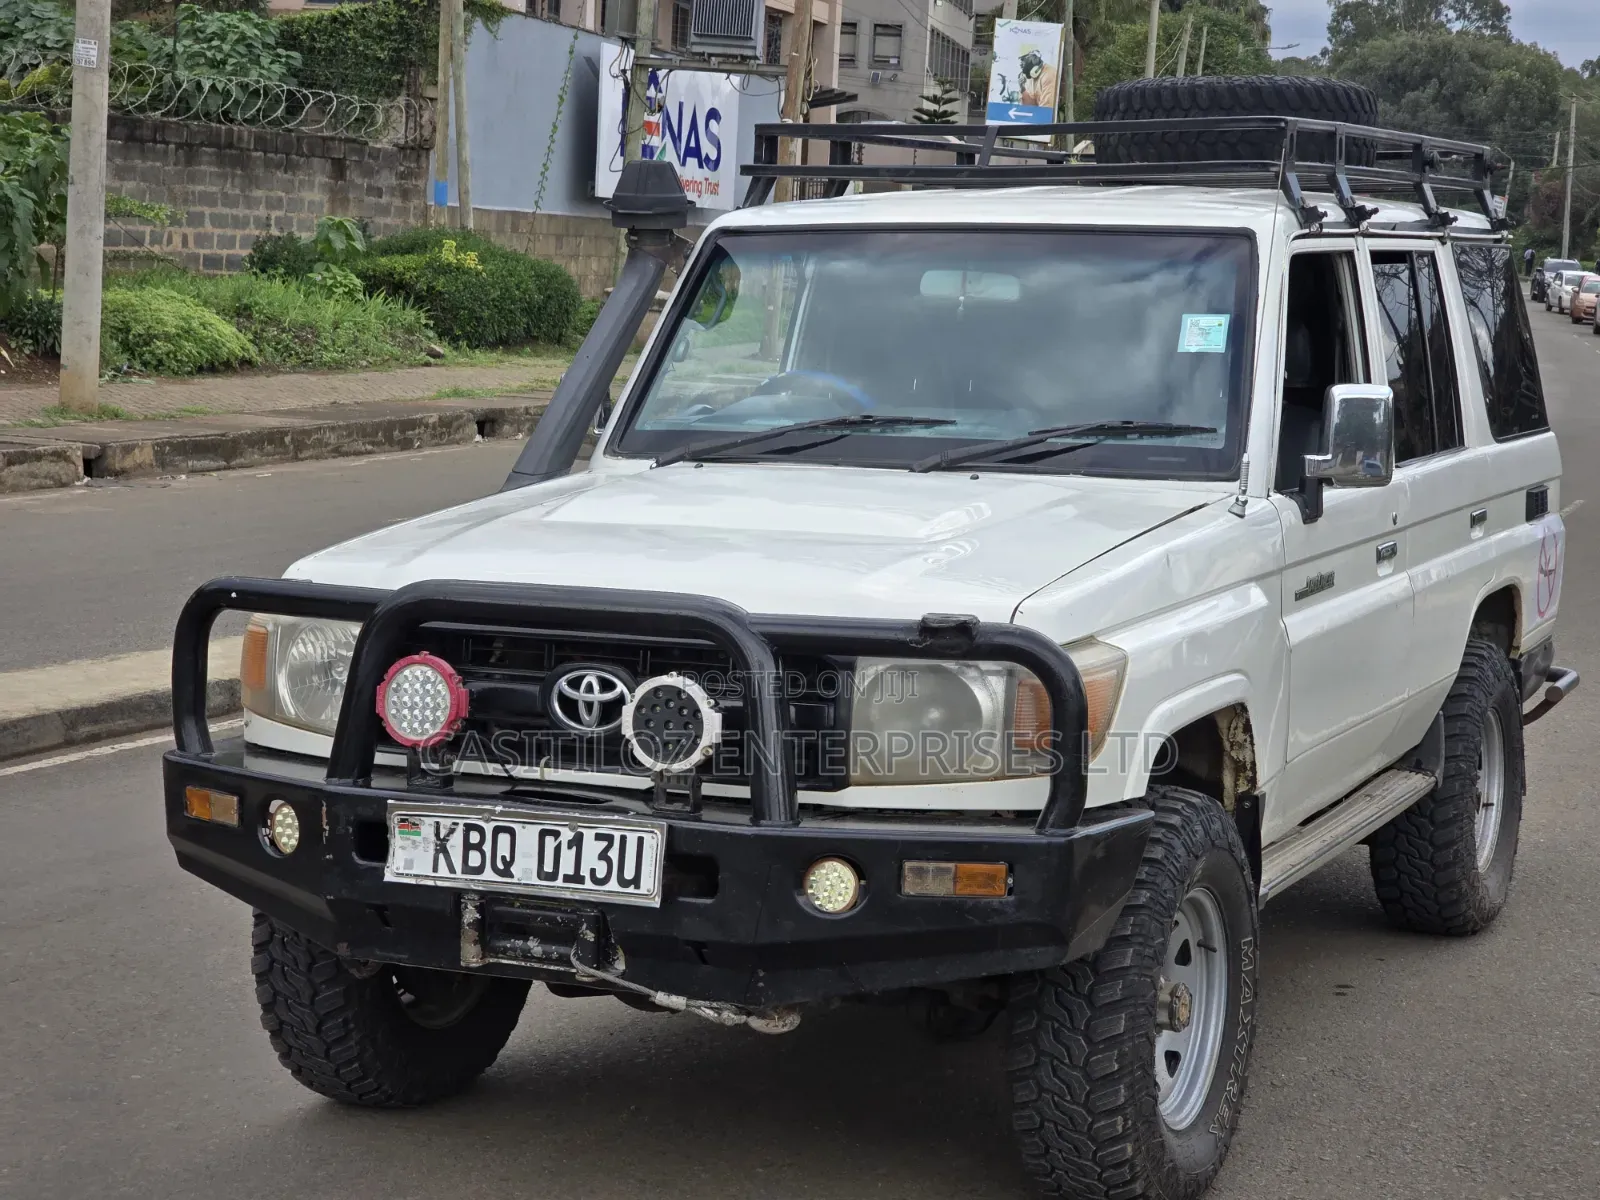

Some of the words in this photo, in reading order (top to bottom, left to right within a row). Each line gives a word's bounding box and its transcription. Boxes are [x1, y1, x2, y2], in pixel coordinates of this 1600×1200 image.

[704, 177, 720, 196] Trust
[431, 820, 517, 879] KBQ
[536, 828, 645, 890] 013U
